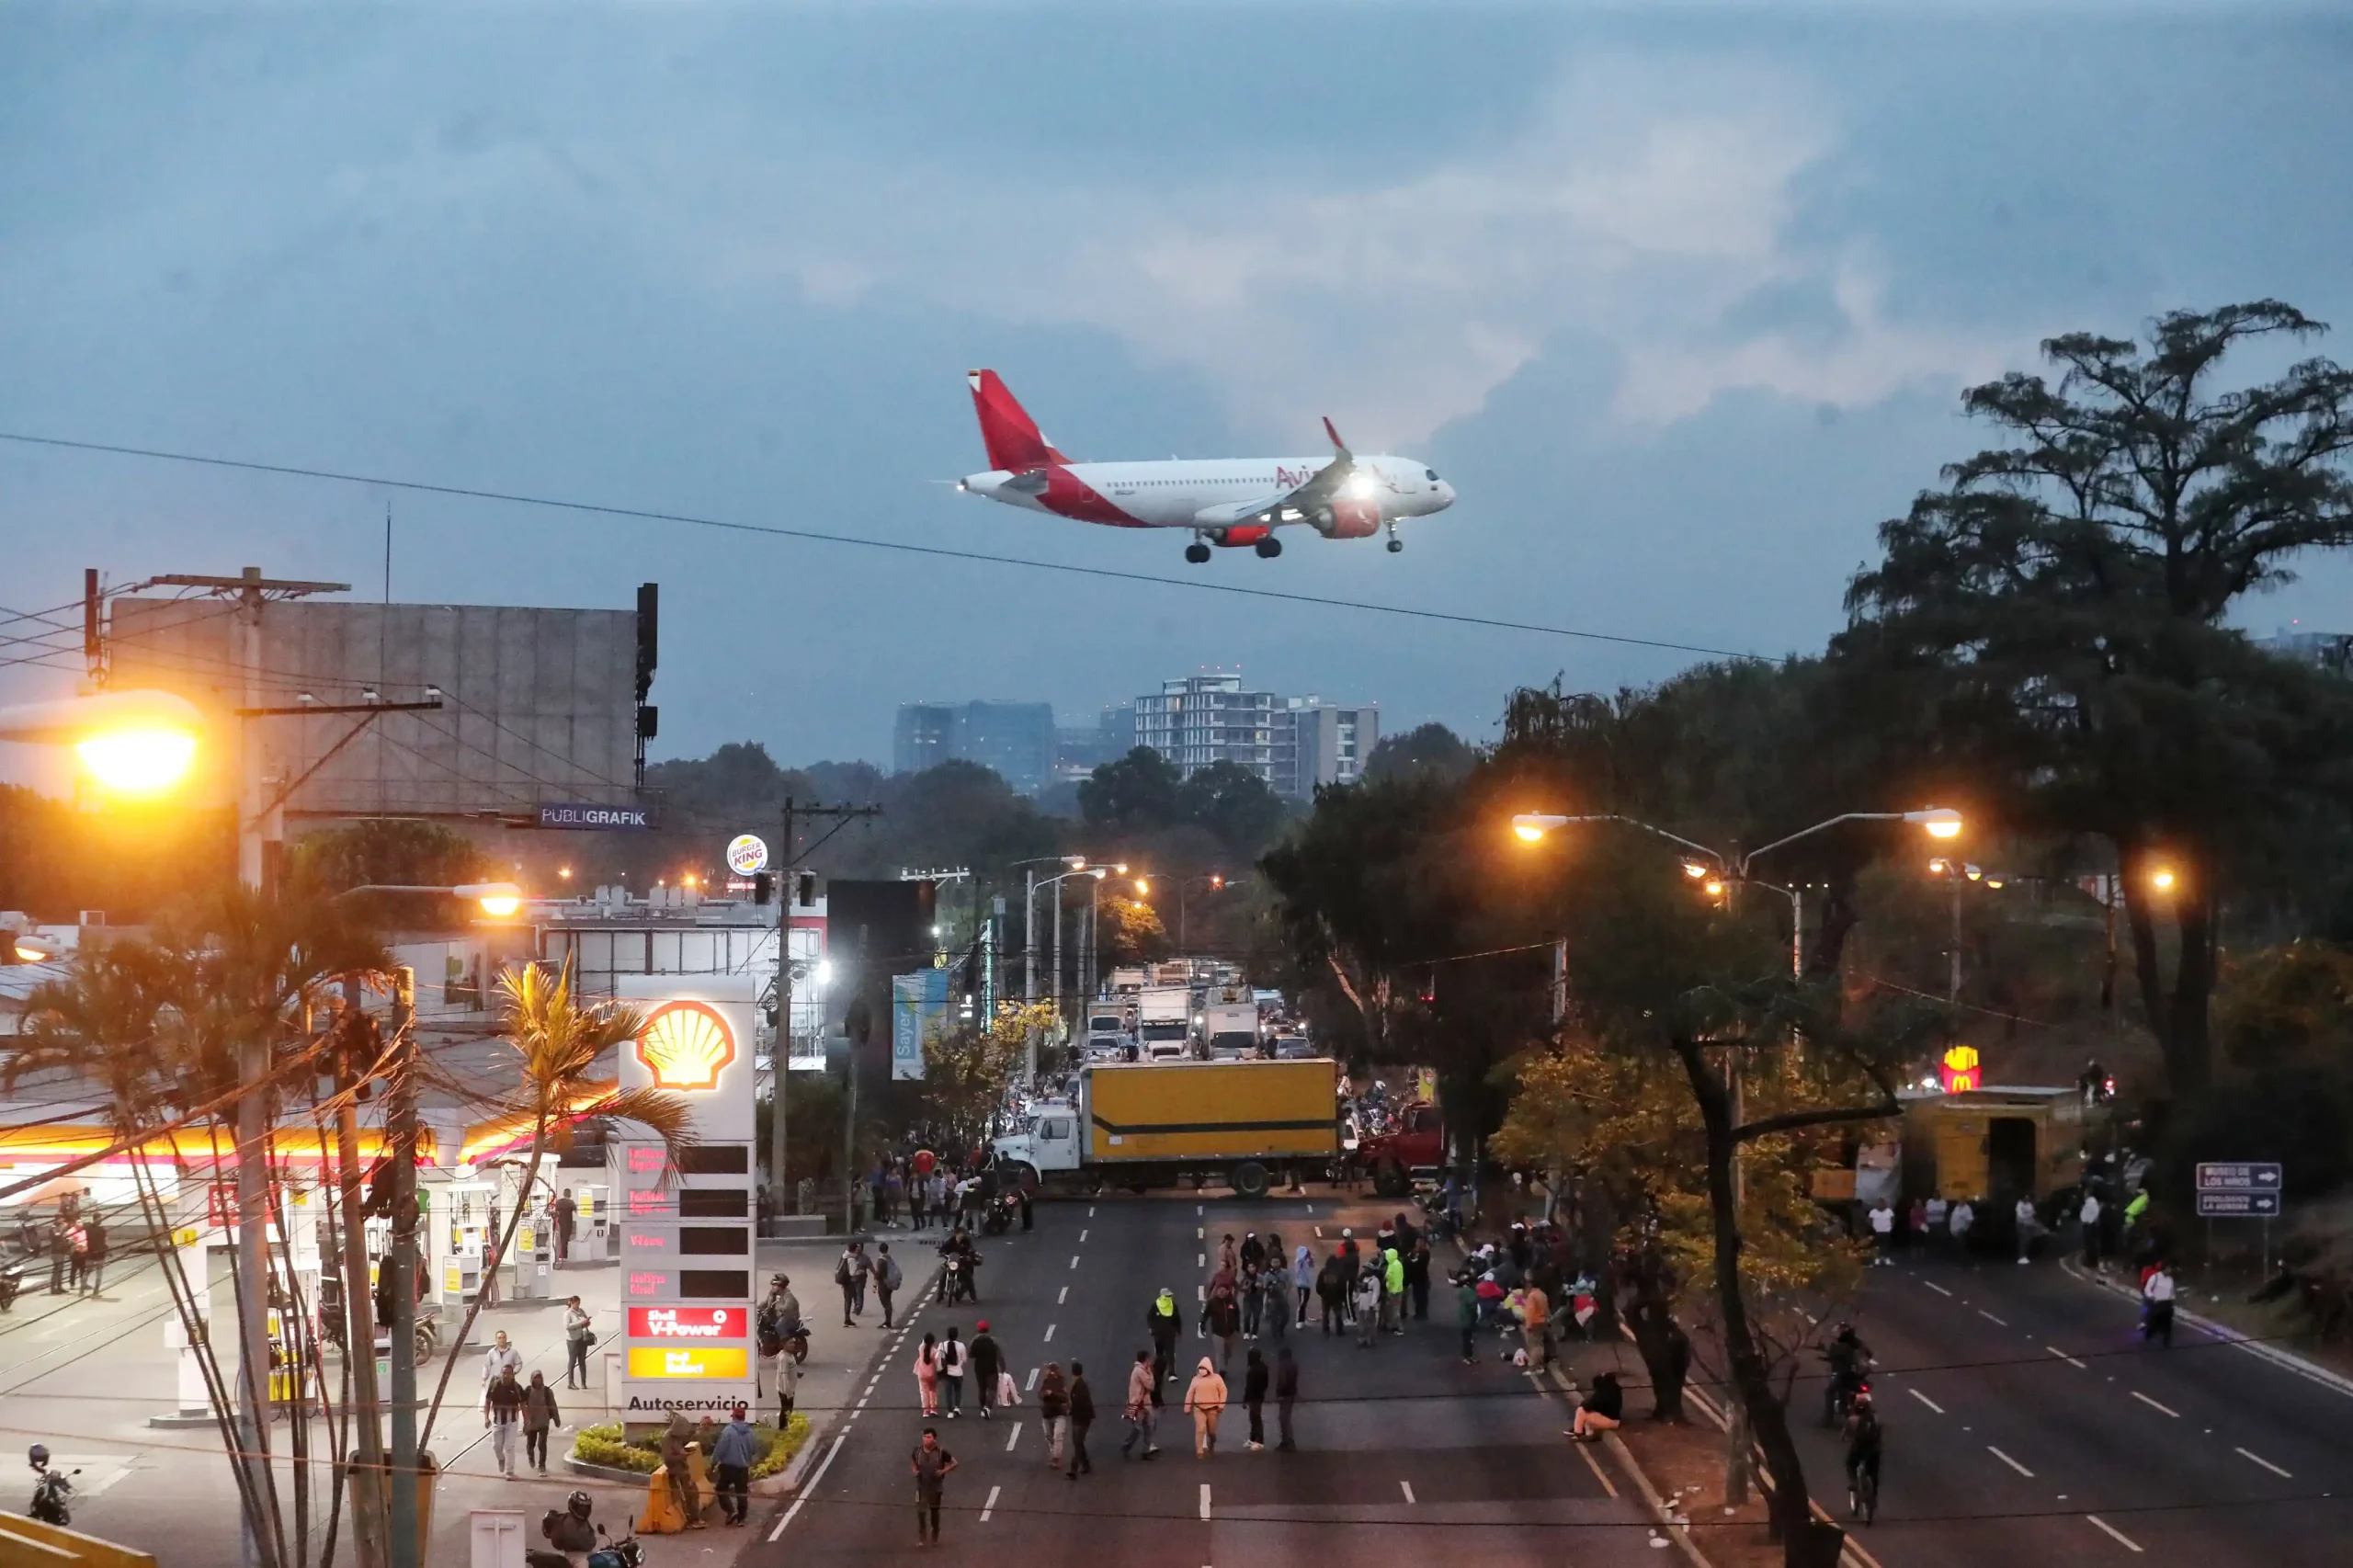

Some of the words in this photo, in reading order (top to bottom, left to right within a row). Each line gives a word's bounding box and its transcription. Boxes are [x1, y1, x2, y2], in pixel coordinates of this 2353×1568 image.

[542, 808, 646, 825] PUBLIGRAFIK
[732, 842, 761, 858] BURGER
[734, 848, 763, 867] KING
[896, 1011, 915, 1056] Sayer
[647, 1309, 677, 1321] Shell
[647, 1321, 722, 1336] V-Power
[628, 1395, 749, 1412] Autoservicio
